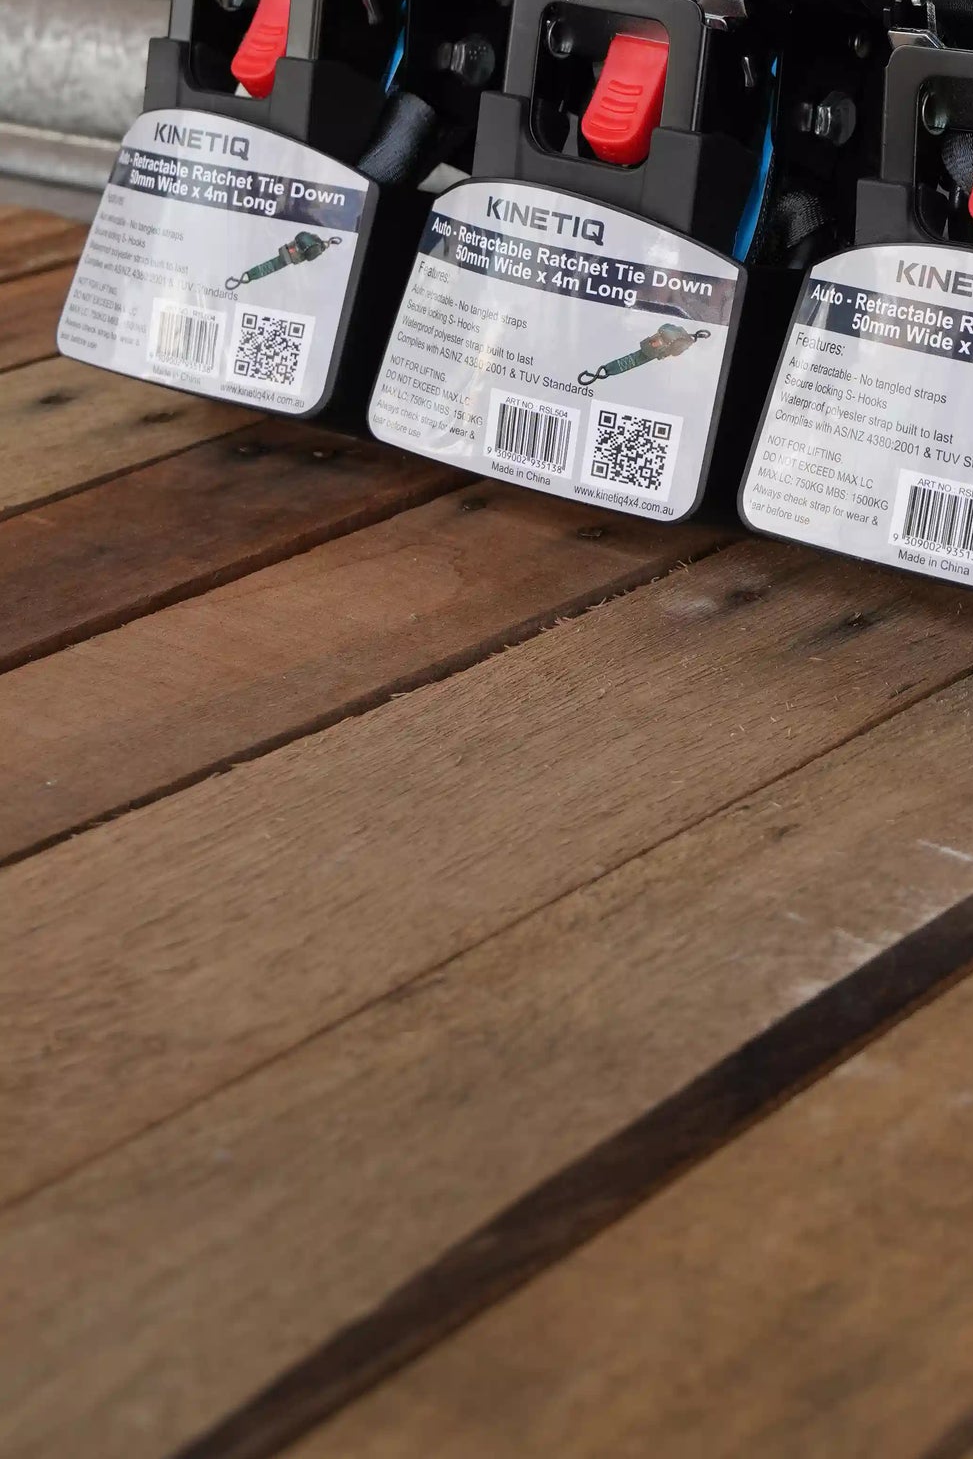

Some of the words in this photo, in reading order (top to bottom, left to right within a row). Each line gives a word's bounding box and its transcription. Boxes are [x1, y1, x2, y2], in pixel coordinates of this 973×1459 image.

[154, 122, 250, 161] KINETIQ
[133, 152, 188, 178] Retractable
[192, 165, 252, 190] Ratchet
[257, 177, 284, 195] Tie
[290, 182, 345, 206] Down
[157, 175, 188, 196] Wide
[191, 186, 200, 198] x
[204, 186, 227, 203] 4m
[232, 190, 277, 216] Long
[487, 196, 605, 246] KINETIQ
[432, 217, 452, 237] Auto
[458, 226, 532, 260] Retractable
[537, 247, 609, 277] Ratchet
[613, 264, 645, 284] Tie
[652, 271, 713, 297] Down
[456, 245, 489, 269] 50mm
[494, 255, 532, 280] Wide
[536, 271, 546, 284] x
[552, 271, 579, 291] 4m
[585, 278, 637, 305] Long
[811, 284, 844, 304] Auto
[854, 293, 954, 329] Retractable
[795, 332, 845, 355] Features:
[851, 313, 901, 337] 50mm
[904, 325, 954, 349] Wide
[958, 340, 972, 354] x
[784, 374, 814, 389] Secure
[814, 382, 844, 400] locking
[845, 389, 855, 400] S-
[857, 393, 888, 408] Hooks
[810, 362, 852, 380] retractable
[859, 374, 873, 385] No
[874, 378, 911, 397] tangled
[913, 387, 947, 404] straps
[774, 409, 813, 429] Complies
[814, 420, 832, 432] with
[833, 425, 864, 441] AS/NZ
[866, 433, 920, 455] 4380:2001
[923, 447, 932, 458] &
[934, 450, 959, 464] TUV
[779, 391, 825, 412] Waterproof
[867, 414, 892, 431] strap
[895, 422, 918, 435] built
[920, 428, 930, 438] to
[933, 430, 953, 443] last
[767, 435, 786, 447] NOT
[787, 440, 805, 452] FOR
[806, 446, 844, 463] LIFTING.
[757, 467, 777, 479] MAX
[779, 473, 793, 484] LC:
[795, 477, 824, 493] 750KG
[825, 486, 848, 499] MBS:
[851, 493, 889, 510] 1500KG
[797, 461, 835, 478] EXCEED
[836, 471, 859, 485] MAX
[859, 477, 873, 488] LC
[918, 478, 935, 487] ART
[898, 550, 925, 564] Made
[928, 557, 937, 566] in
[940, 560, 969, 574] China
[905, 537, 940, 551] 309002
